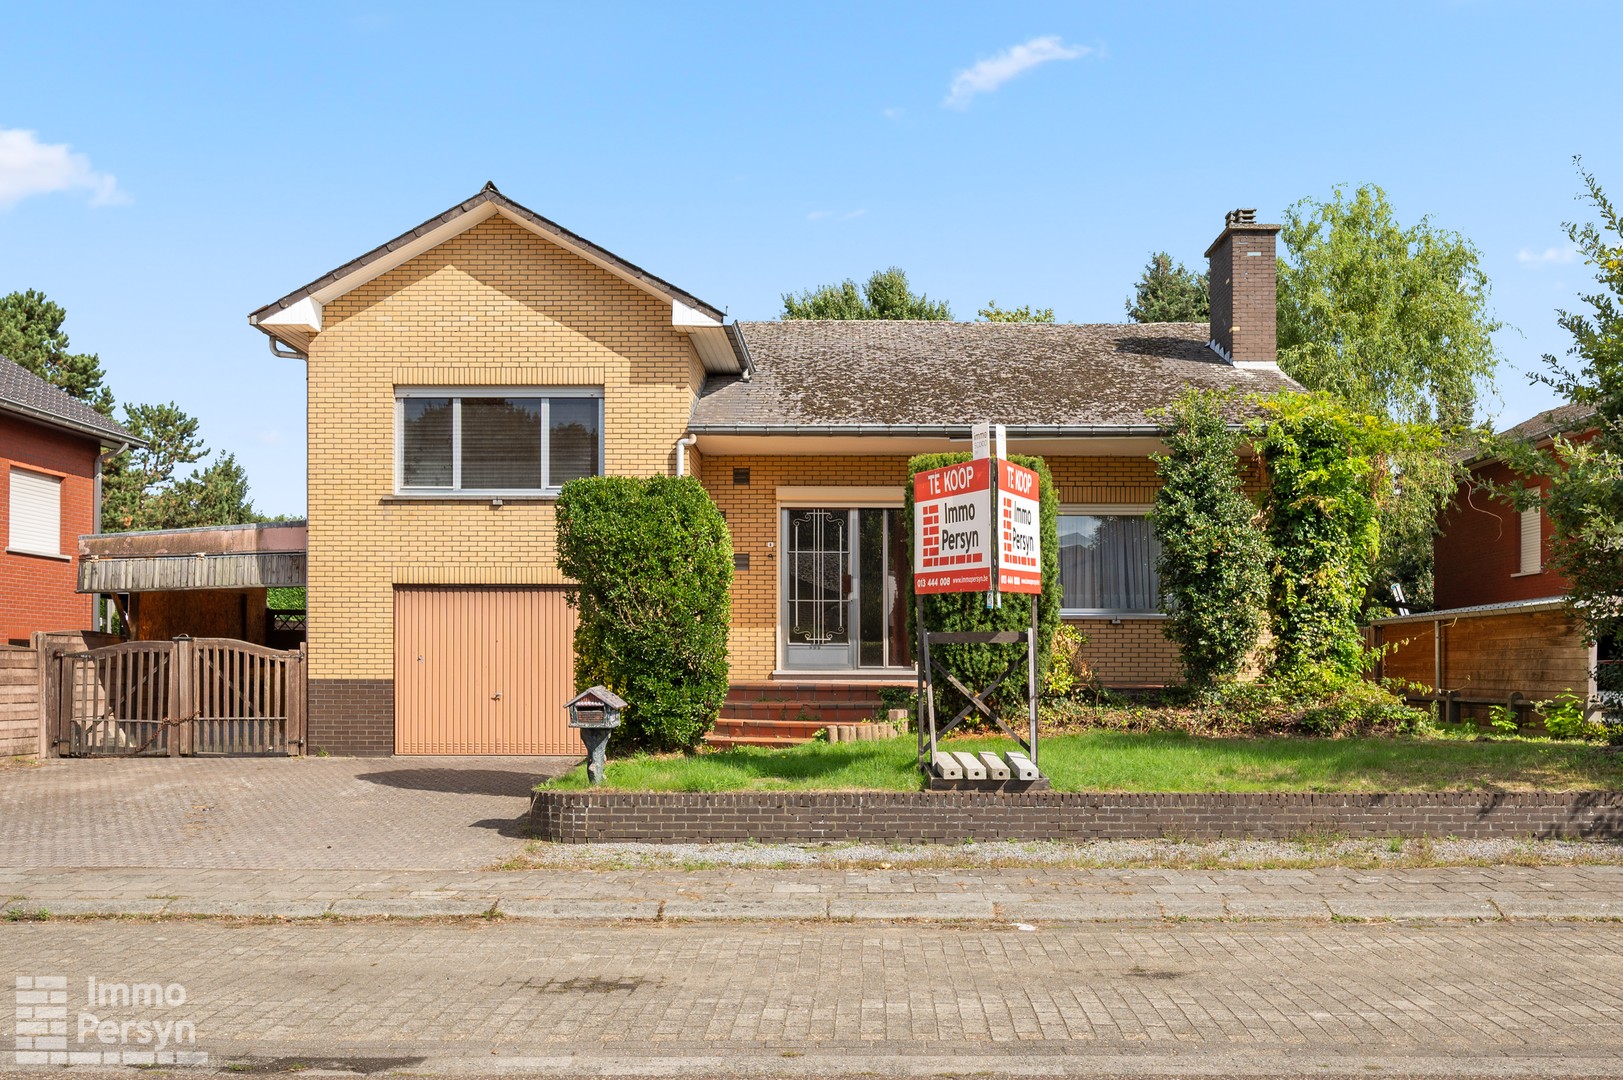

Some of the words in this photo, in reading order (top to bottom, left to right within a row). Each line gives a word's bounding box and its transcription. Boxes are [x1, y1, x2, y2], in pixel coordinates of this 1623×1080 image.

[928, 473, 941, 495] TE
[944, 466, 974, 493] KOOP
[1007, 466, 1015, 488] TE
[1015, 471, 1032, 494] KOOP
[944, 503, 976, 524] Immo
[1014, 501, 1032, 526] Immo
[942, 529, 979, 554] Persyn
[1013, 529, 1034, 556] Persyn
[917, 579, 926, 588] 013
[928, 578, 938, 587] 444
[940, 577, 951, 586] 008
